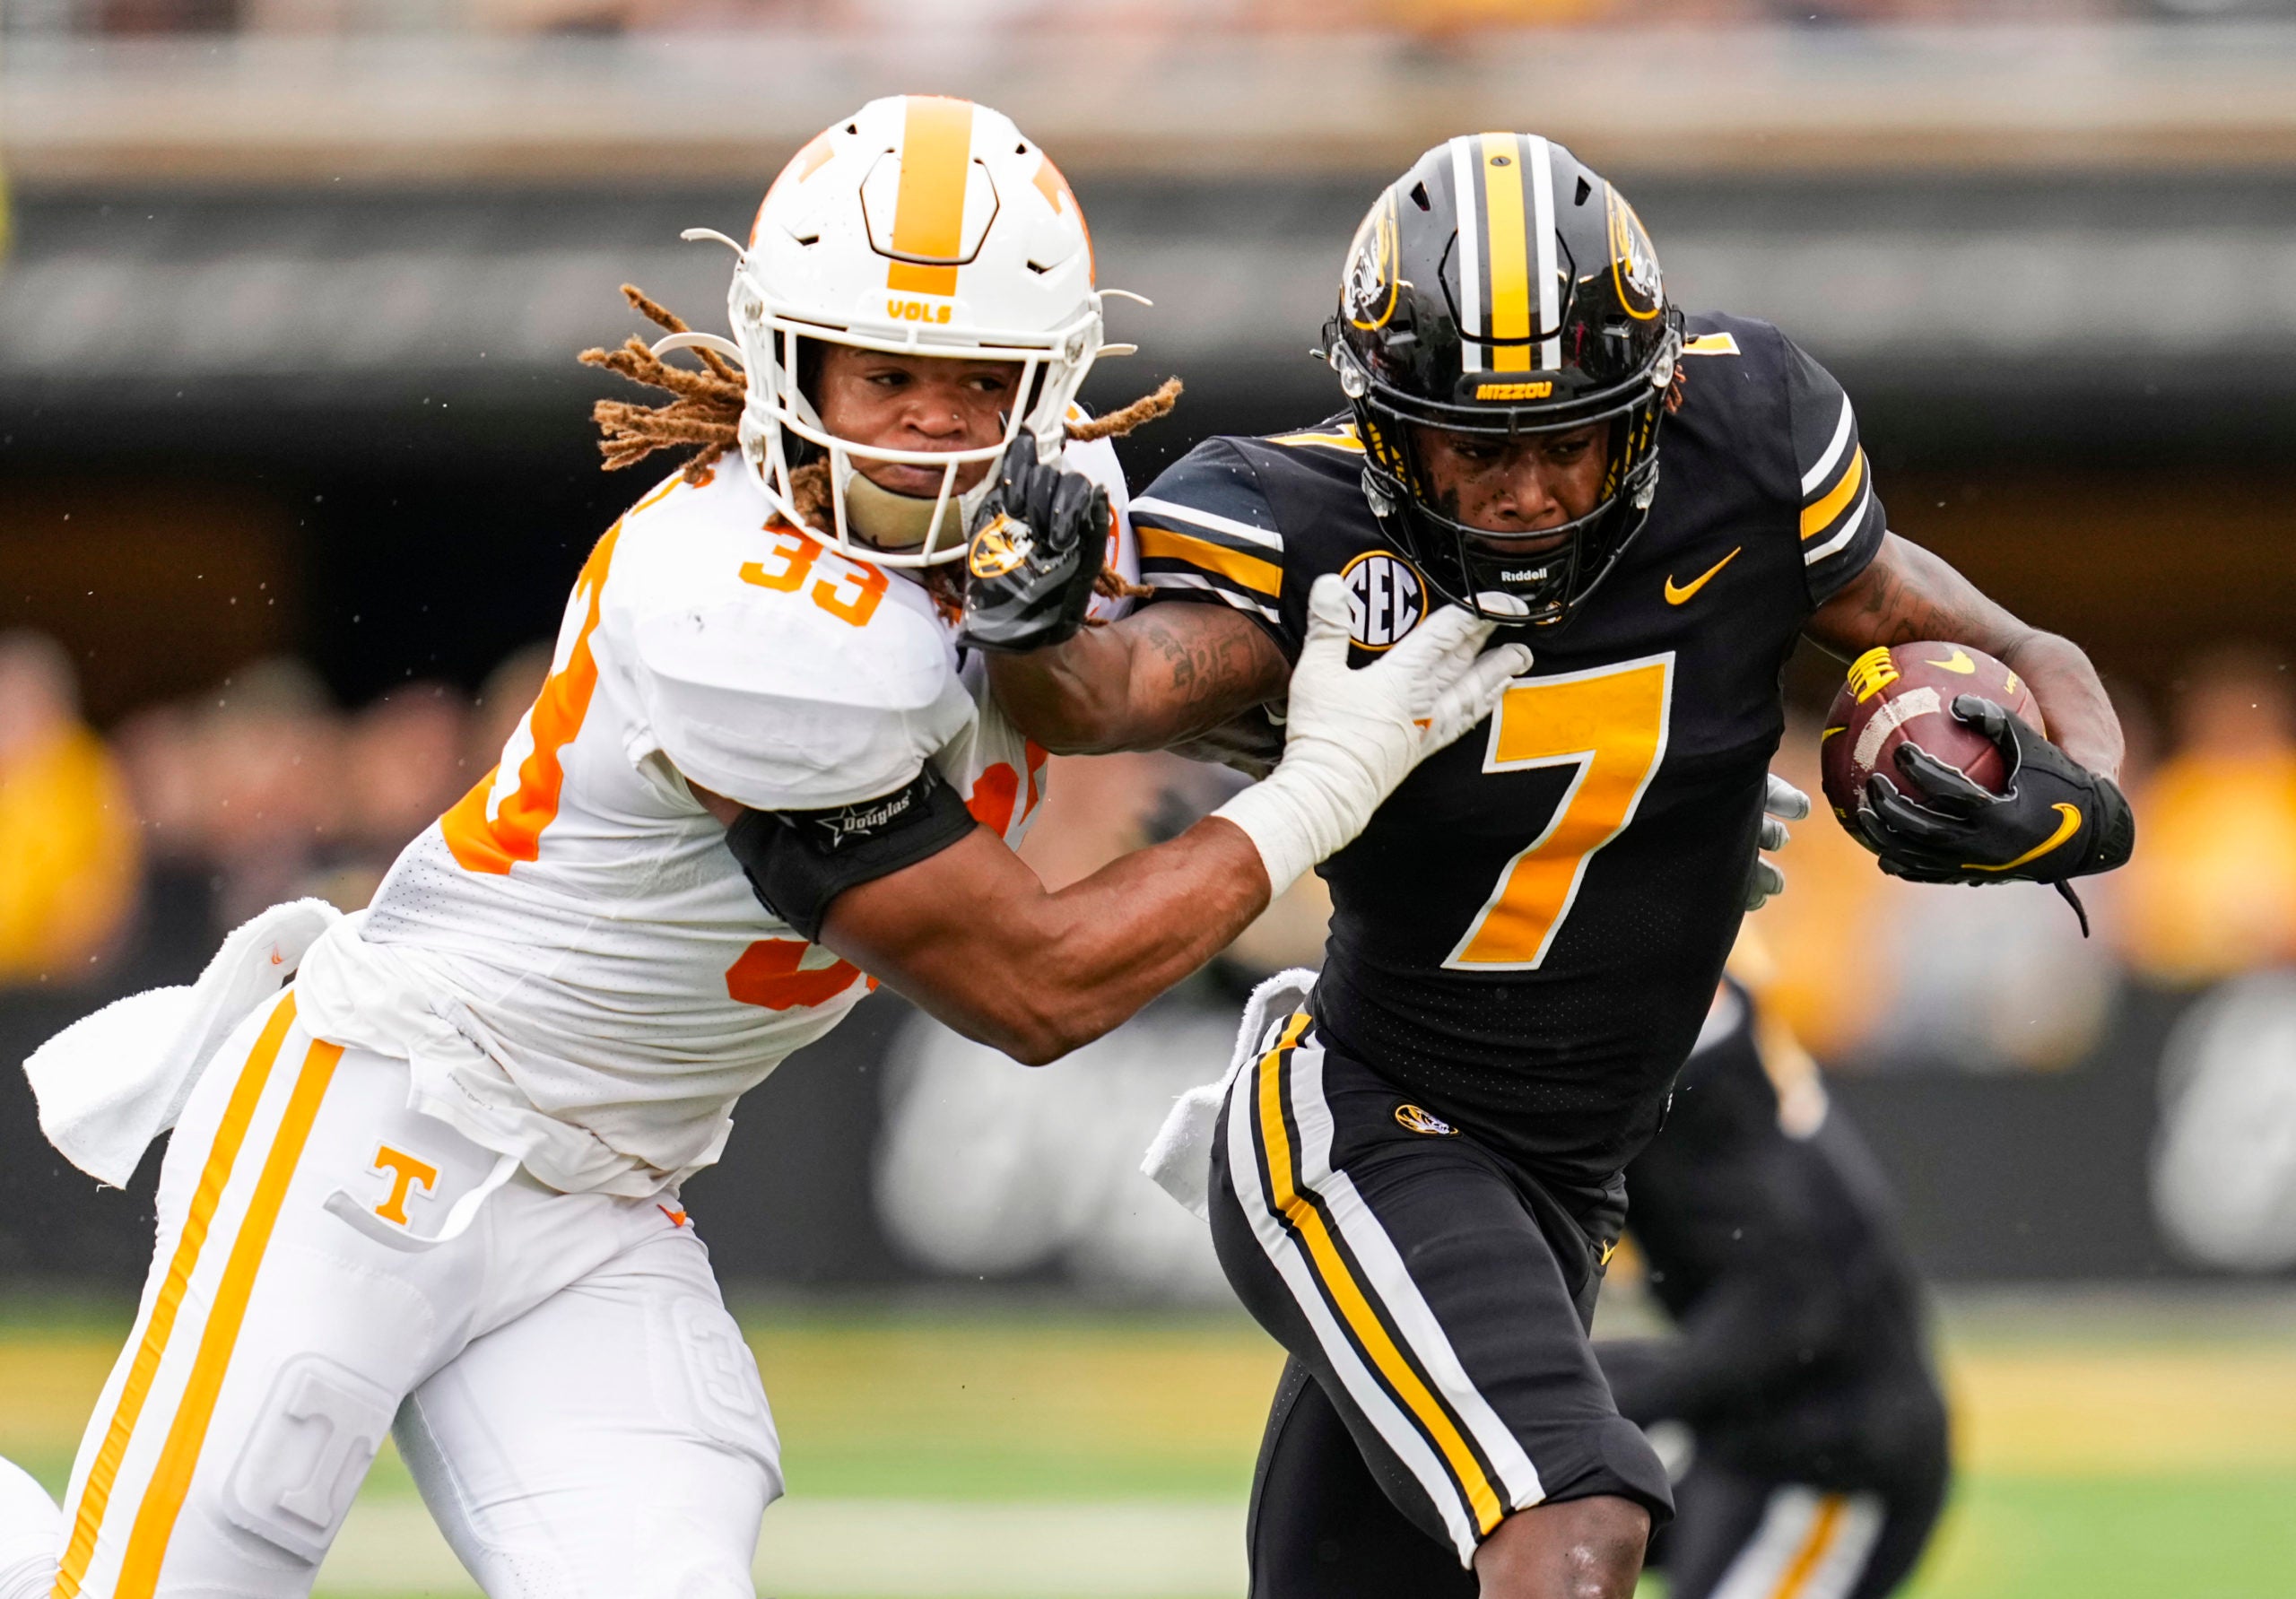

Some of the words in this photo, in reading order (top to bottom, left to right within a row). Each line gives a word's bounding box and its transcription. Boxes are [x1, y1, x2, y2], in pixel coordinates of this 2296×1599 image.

[886, 299, 952, 324] VOLS
[1476, 381, 1552, 400] MIZZOU
[738, 524, 890, 627] 33
[1344, 556, 1419, 645] SEC
[1500, 567, 1547, 582] Riddell
[842, 794, 910, 832] Douglas
[1440, 650, 1676, 971] 7
[374, 1144, 438, 1226] T
